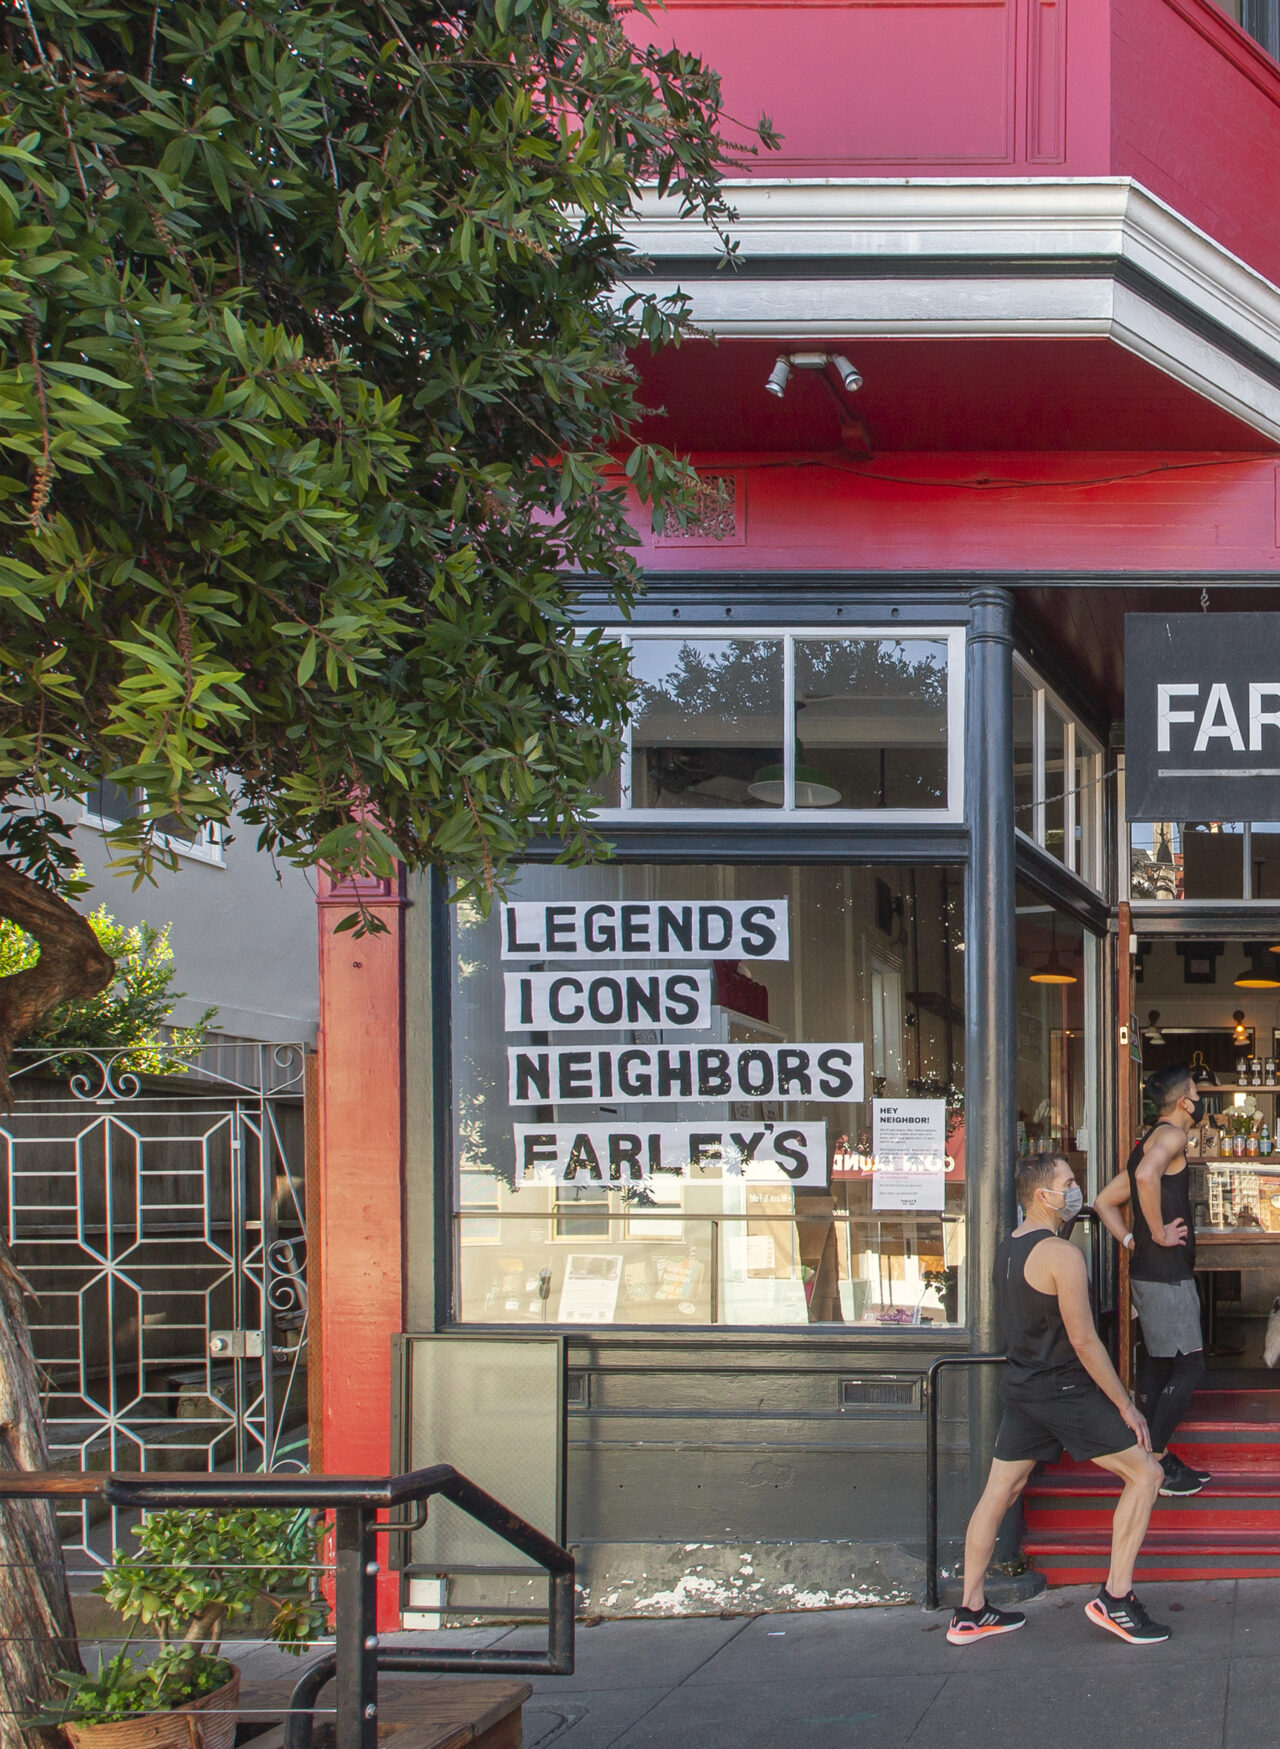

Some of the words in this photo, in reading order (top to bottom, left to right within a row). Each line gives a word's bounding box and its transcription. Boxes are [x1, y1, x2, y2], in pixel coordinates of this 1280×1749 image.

[507, 904, 778, 957] LEGENDS
[516, 1048, 855, 1100] NEIGHBORS
[880, 1116, 930, 1124] NEIGHBOR!
[522, 1122, 810, 1180] FARLEY'S
